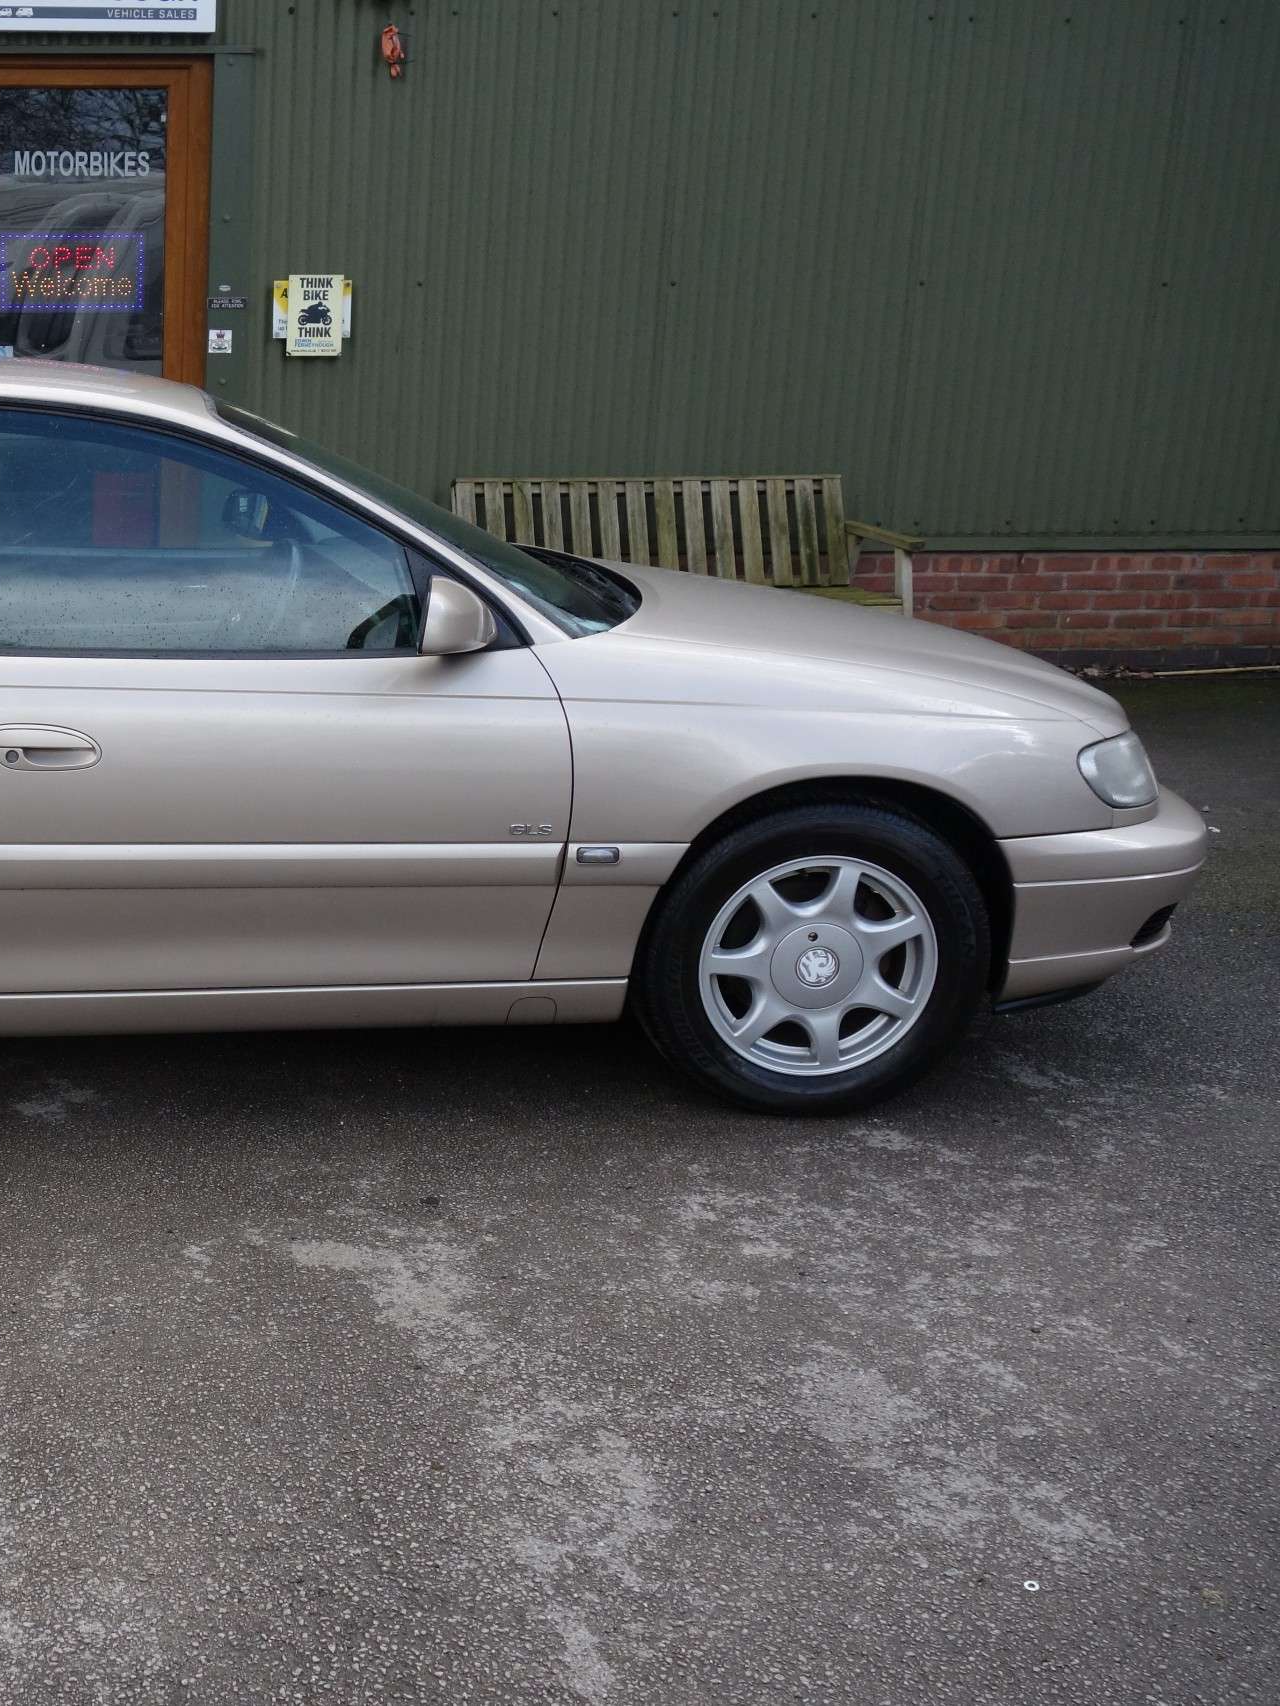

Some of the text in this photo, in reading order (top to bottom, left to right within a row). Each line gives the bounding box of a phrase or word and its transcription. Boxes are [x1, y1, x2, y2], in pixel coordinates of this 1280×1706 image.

[107, 8, 194, 19] VEHICLE SALES
[14, 150, 150, 177] MOTORBIKES
[30, 246, 116, 269] OPEN
[12, 271, 132, 296] Welcome
[299, 277, 333, 288] THINK
[303, 290, 329, 300] BIKE
[298, 327, 332, 337] THINK
[510, 824, 553, 835] GLS
